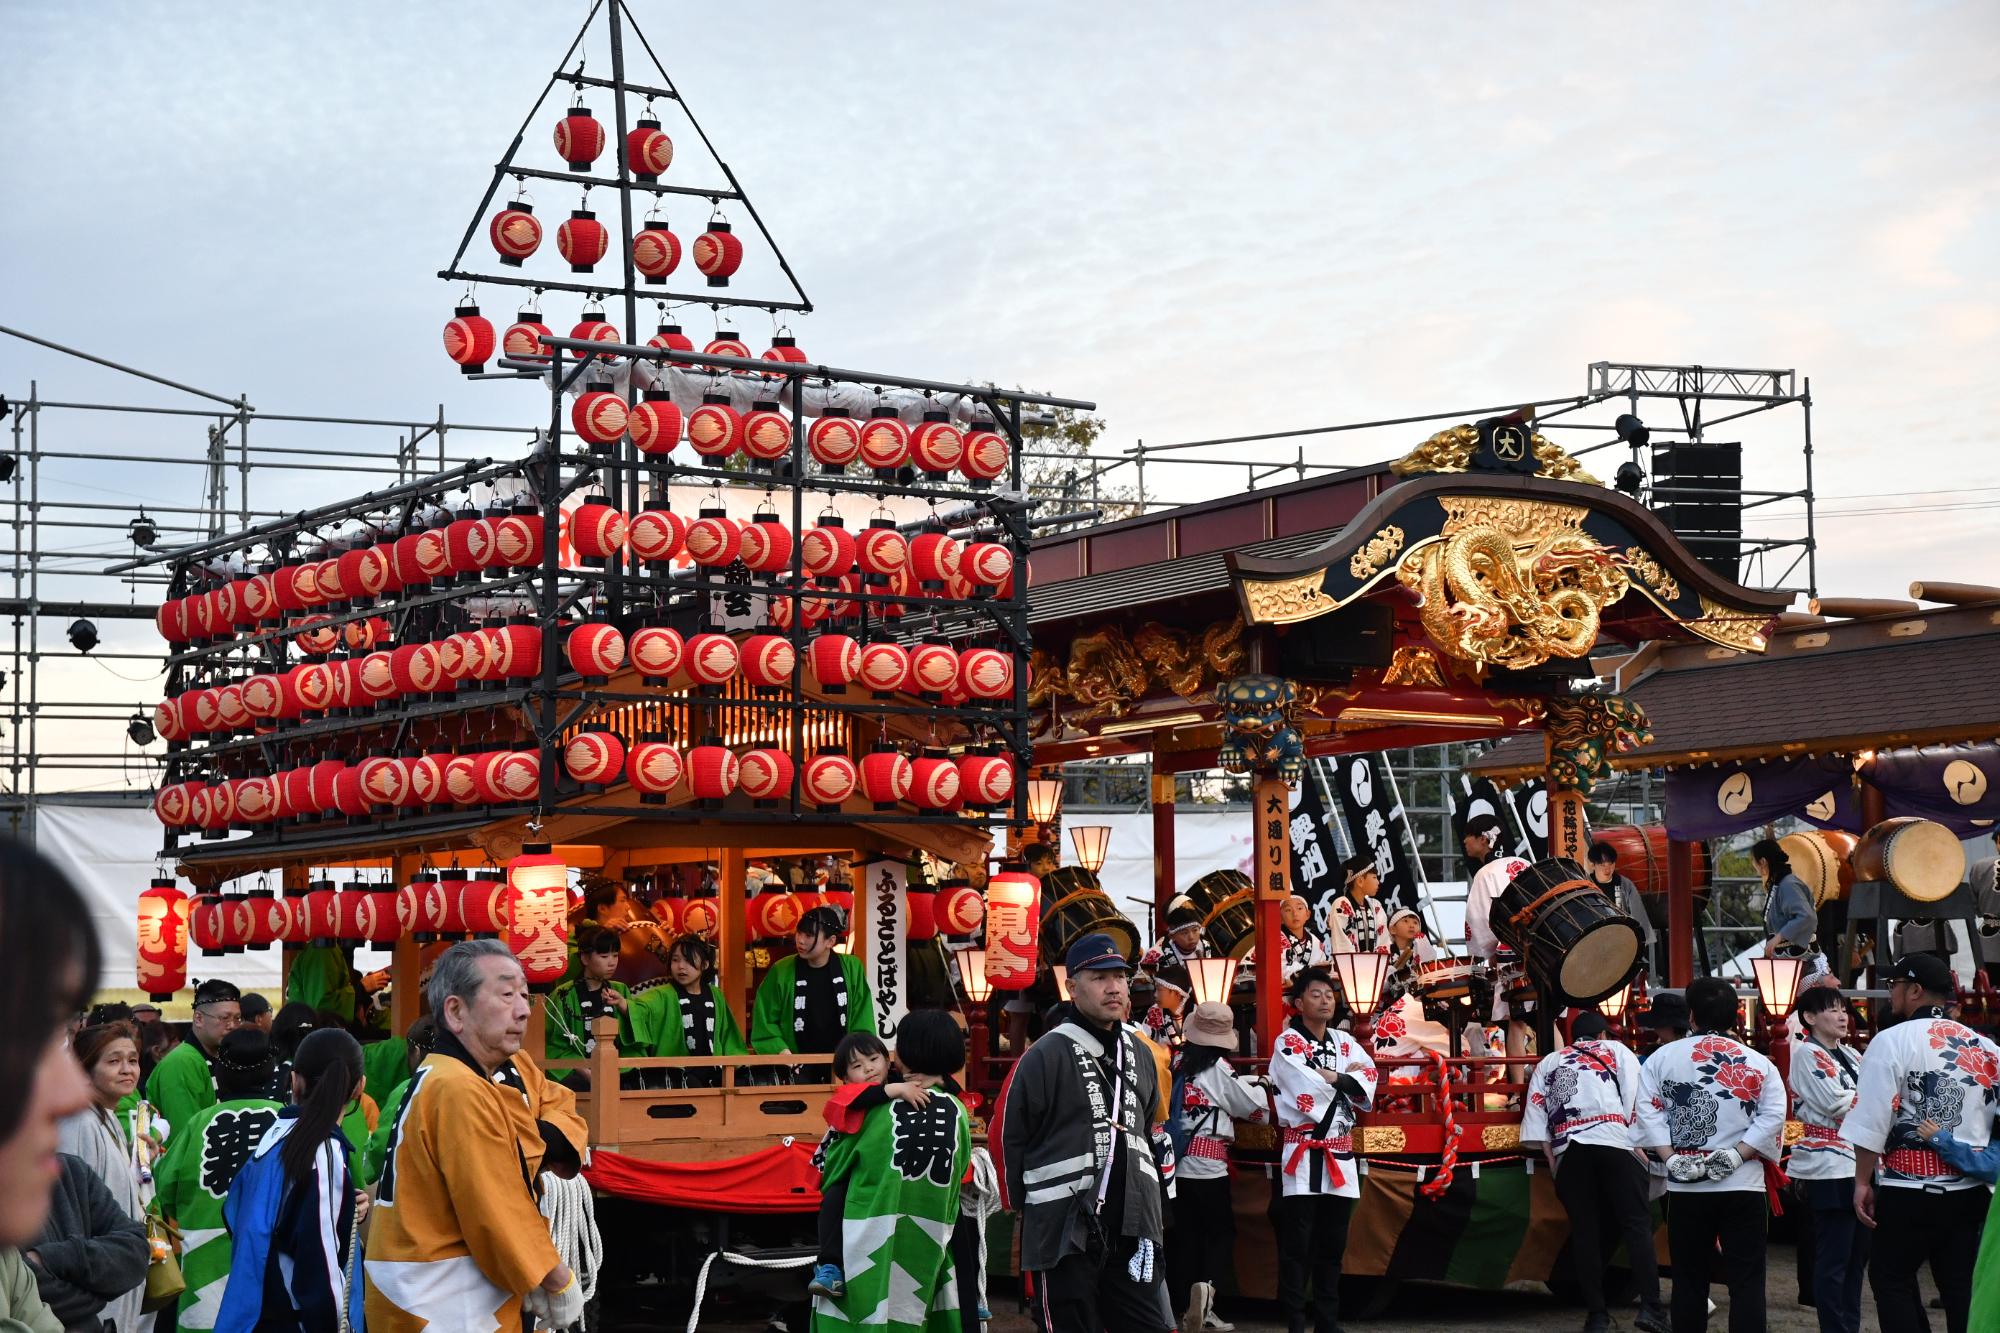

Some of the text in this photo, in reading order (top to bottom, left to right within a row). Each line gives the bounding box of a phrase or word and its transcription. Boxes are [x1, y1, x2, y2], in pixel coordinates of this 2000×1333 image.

[1498, 431, 1517, 456] 大
[1266, 794, 1285, 892] 大通り組
